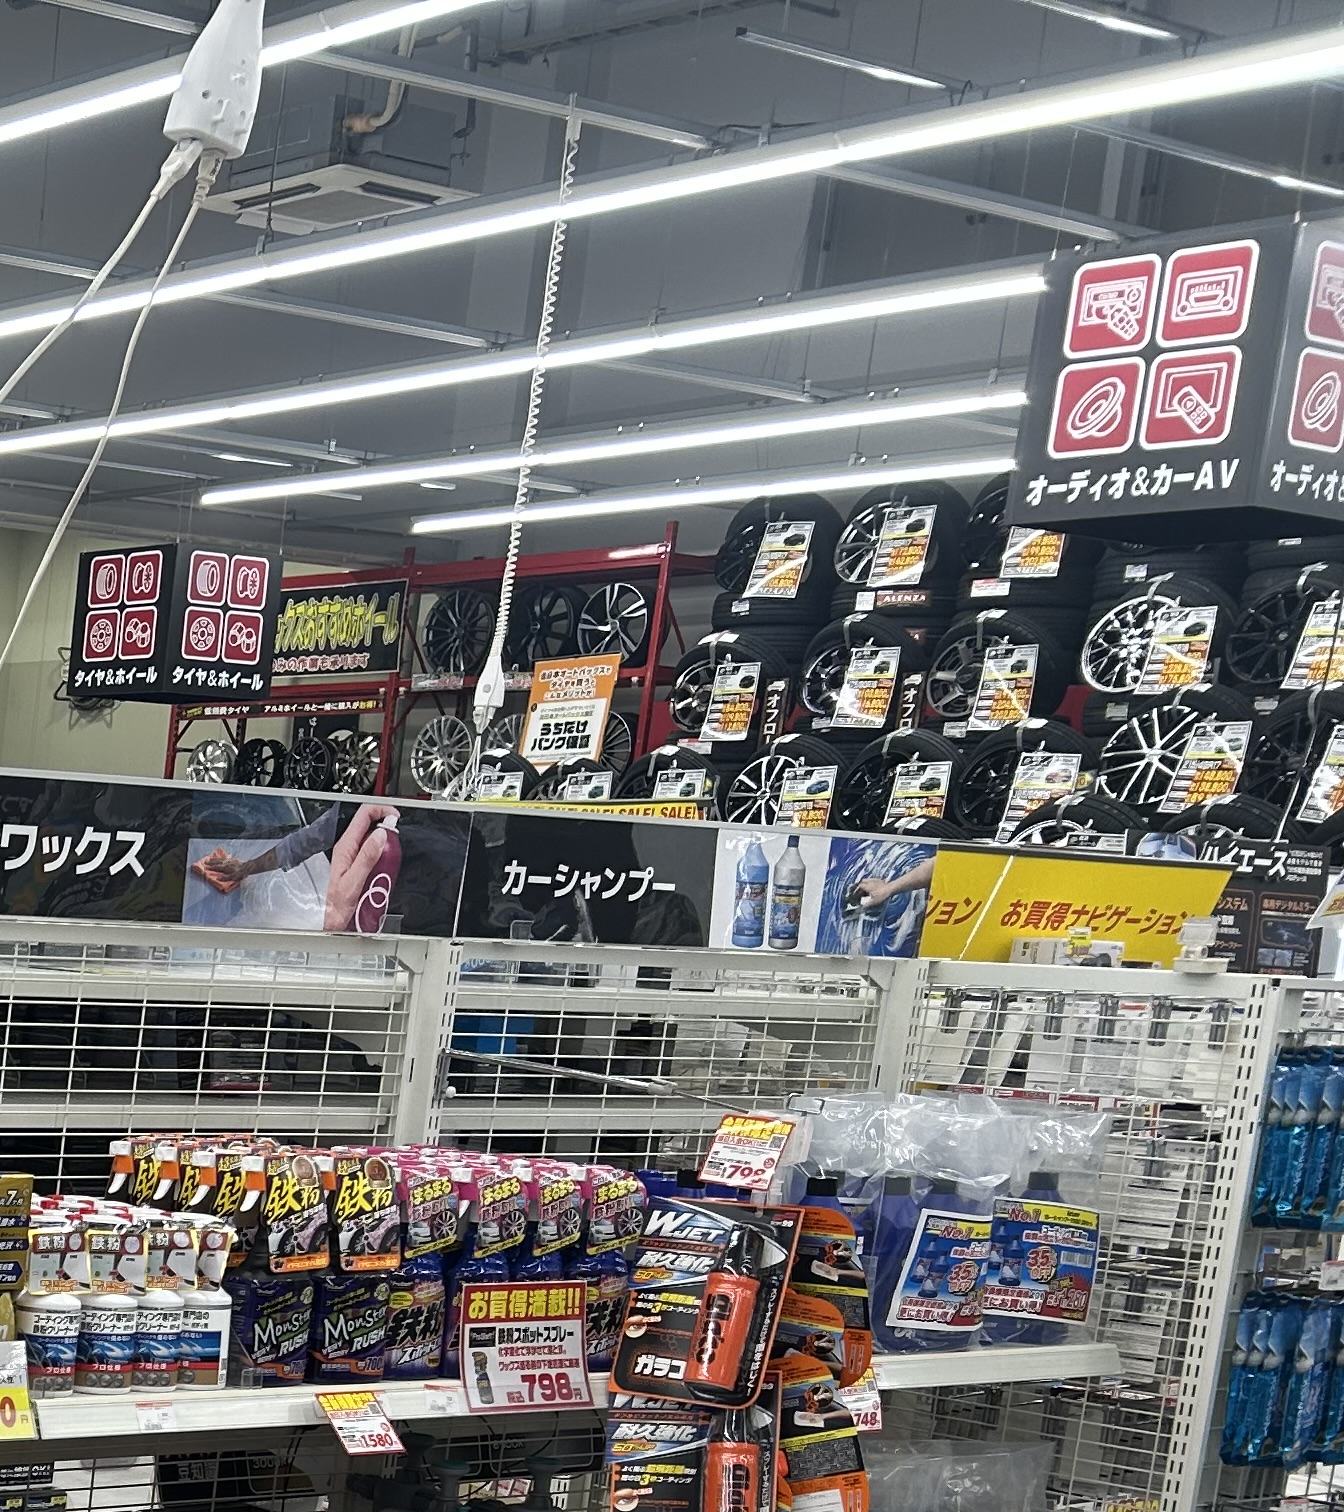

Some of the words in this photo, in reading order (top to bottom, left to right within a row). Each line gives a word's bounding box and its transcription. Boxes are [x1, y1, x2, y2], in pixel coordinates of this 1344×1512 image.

[1026, 458, 1239, 506] オーディオ&カーAV
[74, 666, 158, 686] タイヤ&ホイール
[172, 665, 264, 691] タイヤ&ホイール
[662, 806, 696, 819] SALE!
[502, 859, 676, 901] カーシャンプー
[468, 1288, 580, 1319] お買得満載!!
[520, 1372, 572, 1402] 798
